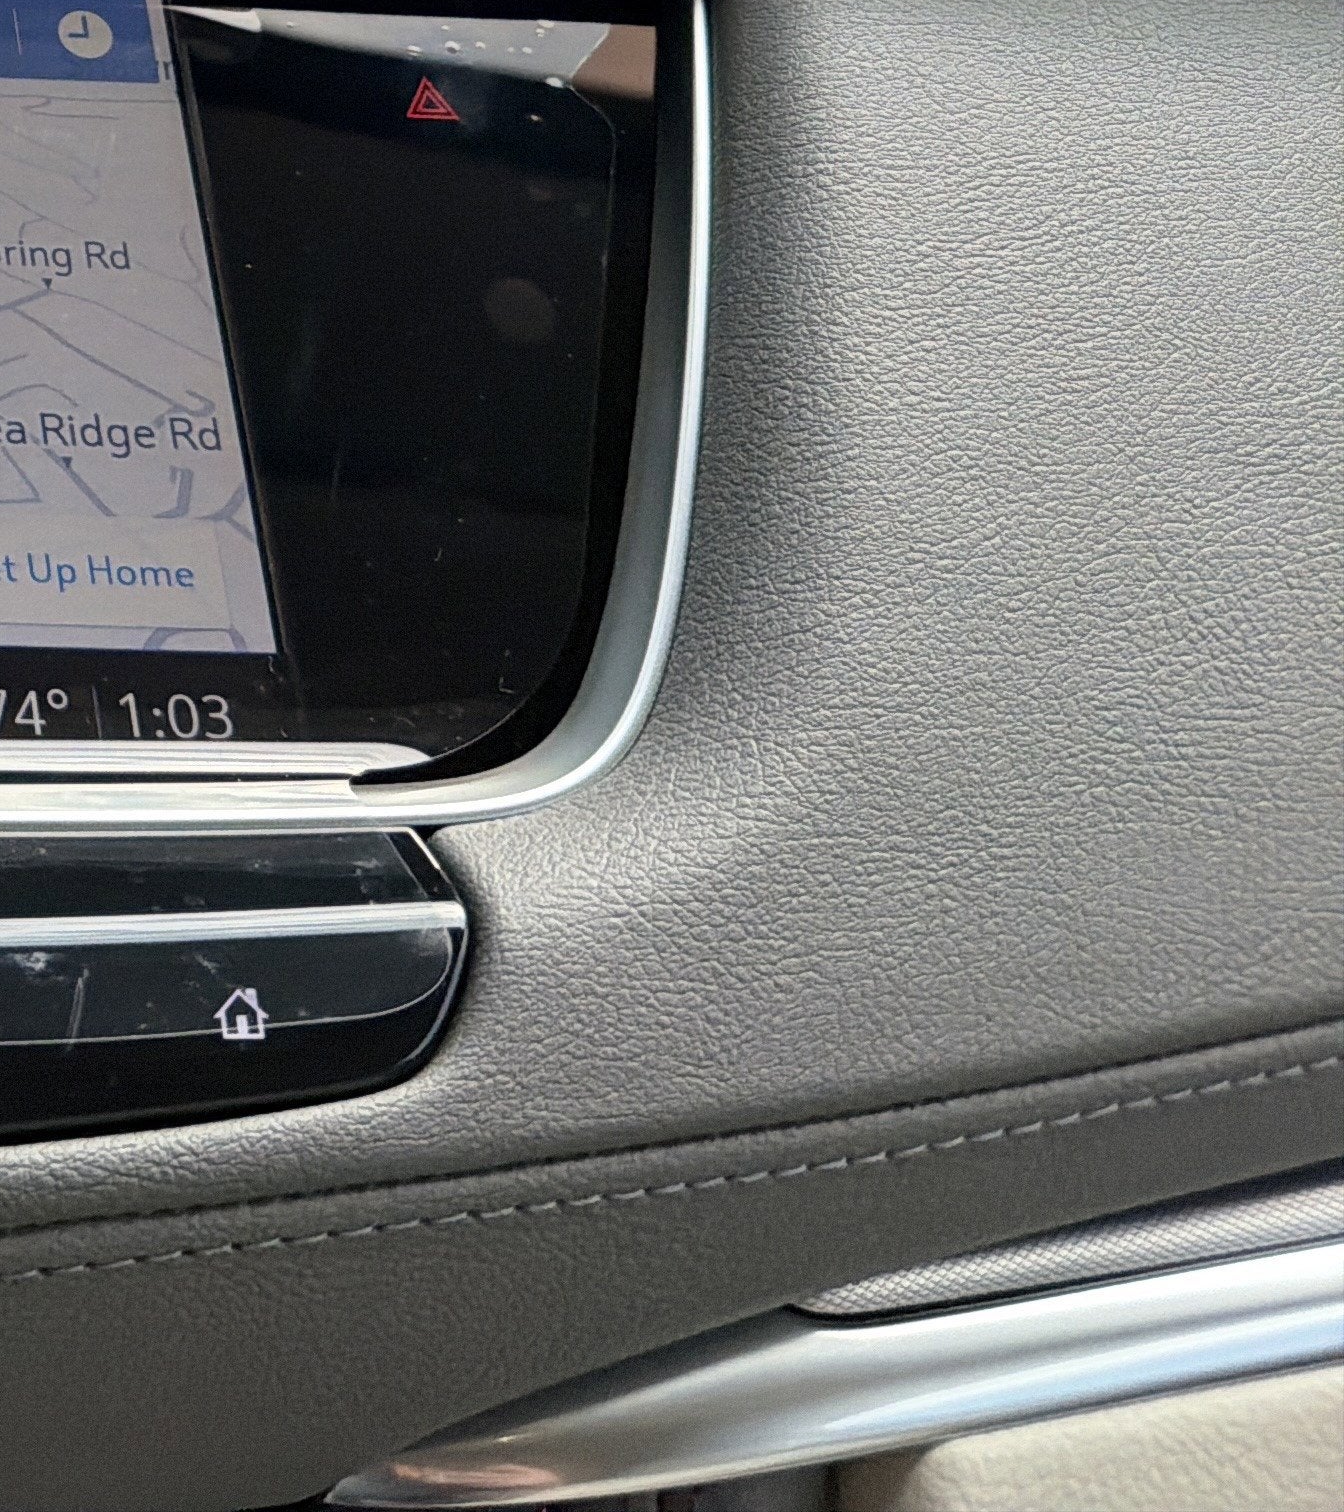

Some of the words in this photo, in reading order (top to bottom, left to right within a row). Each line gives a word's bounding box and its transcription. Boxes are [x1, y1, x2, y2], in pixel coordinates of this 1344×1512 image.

[85, 241, 130, 271] Rd
[40, 417, 155, 458] Ridge
[169, 420, 222, 452] Rd
[29, 553, 77, 588] Up
[87, 558, 195, 589] Home
[118, 692, 234, 739] 1:03
